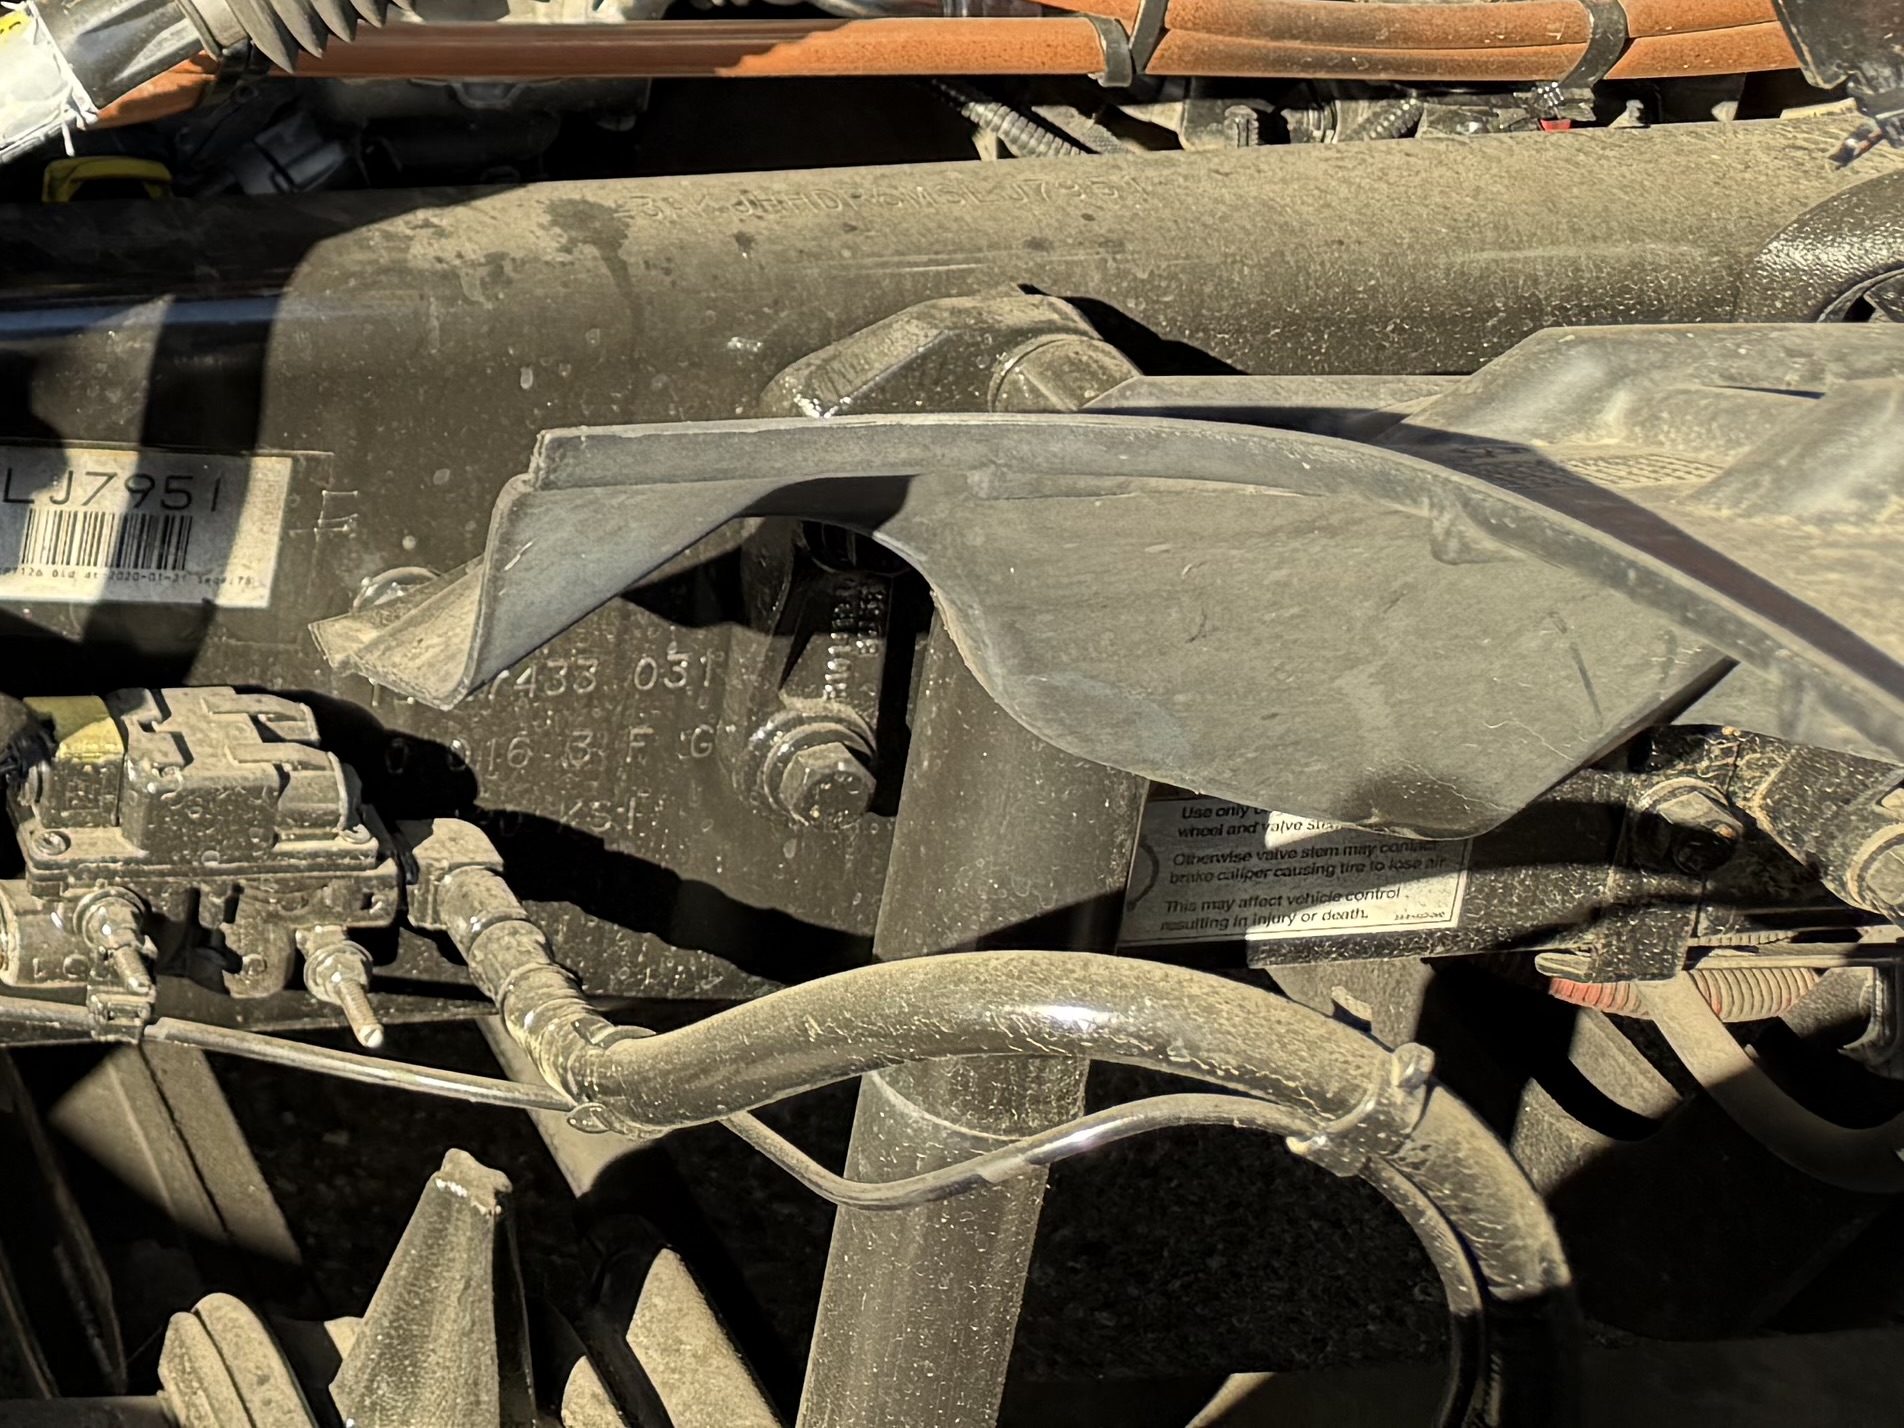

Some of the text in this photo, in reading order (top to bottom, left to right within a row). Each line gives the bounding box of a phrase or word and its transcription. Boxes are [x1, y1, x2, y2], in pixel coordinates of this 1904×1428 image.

[1, 467, 223, 513] LJ7951
[1181, 804, 1249, 819] Use only
[1177, 819, 1304, 838] wheel and valve
[1173, 844, 1377, 867] Otherwise valve stem may
[1169, 870, 1215, 884] brake
[1217, 867, 1273, 883] caliper
[1273, 864, 1335, 880] causing
[1340, 862, 1366, 875] tire
[1369, 861, 1384, 873] to
[1389, 859, 1422, 872] lose
[1165, 887, 1402, 914] This may affect vehicle control
[1160, 907, 1370, 932] resulting in injury or death.
